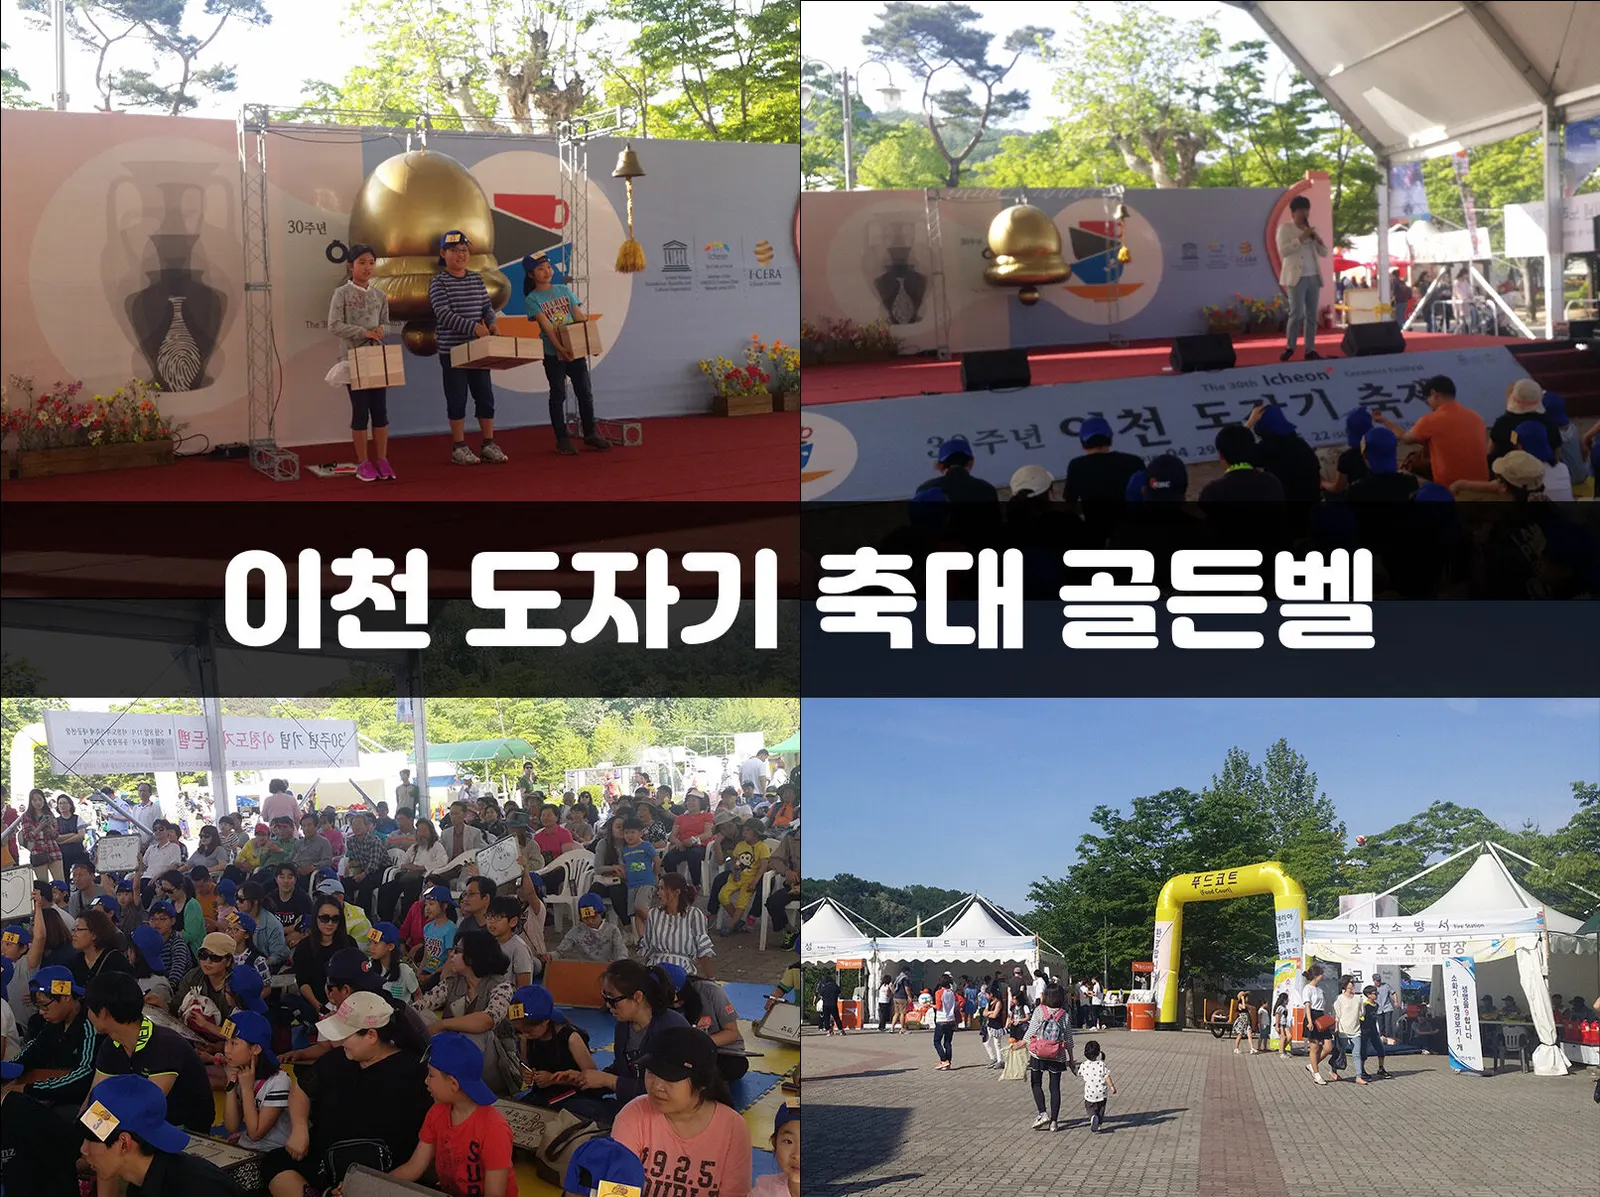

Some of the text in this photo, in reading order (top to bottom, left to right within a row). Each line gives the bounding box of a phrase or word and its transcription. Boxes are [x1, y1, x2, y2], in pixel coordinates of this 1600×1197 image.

[287, 219, 328, 236] 30주년
[1202, 383, 1226, 393] The
[1262, 371, 1330, 386] Icheon
[1191, 870, 1239, 889] 푸드코트
[1348, 919, 1450, 934] 이천소방서
